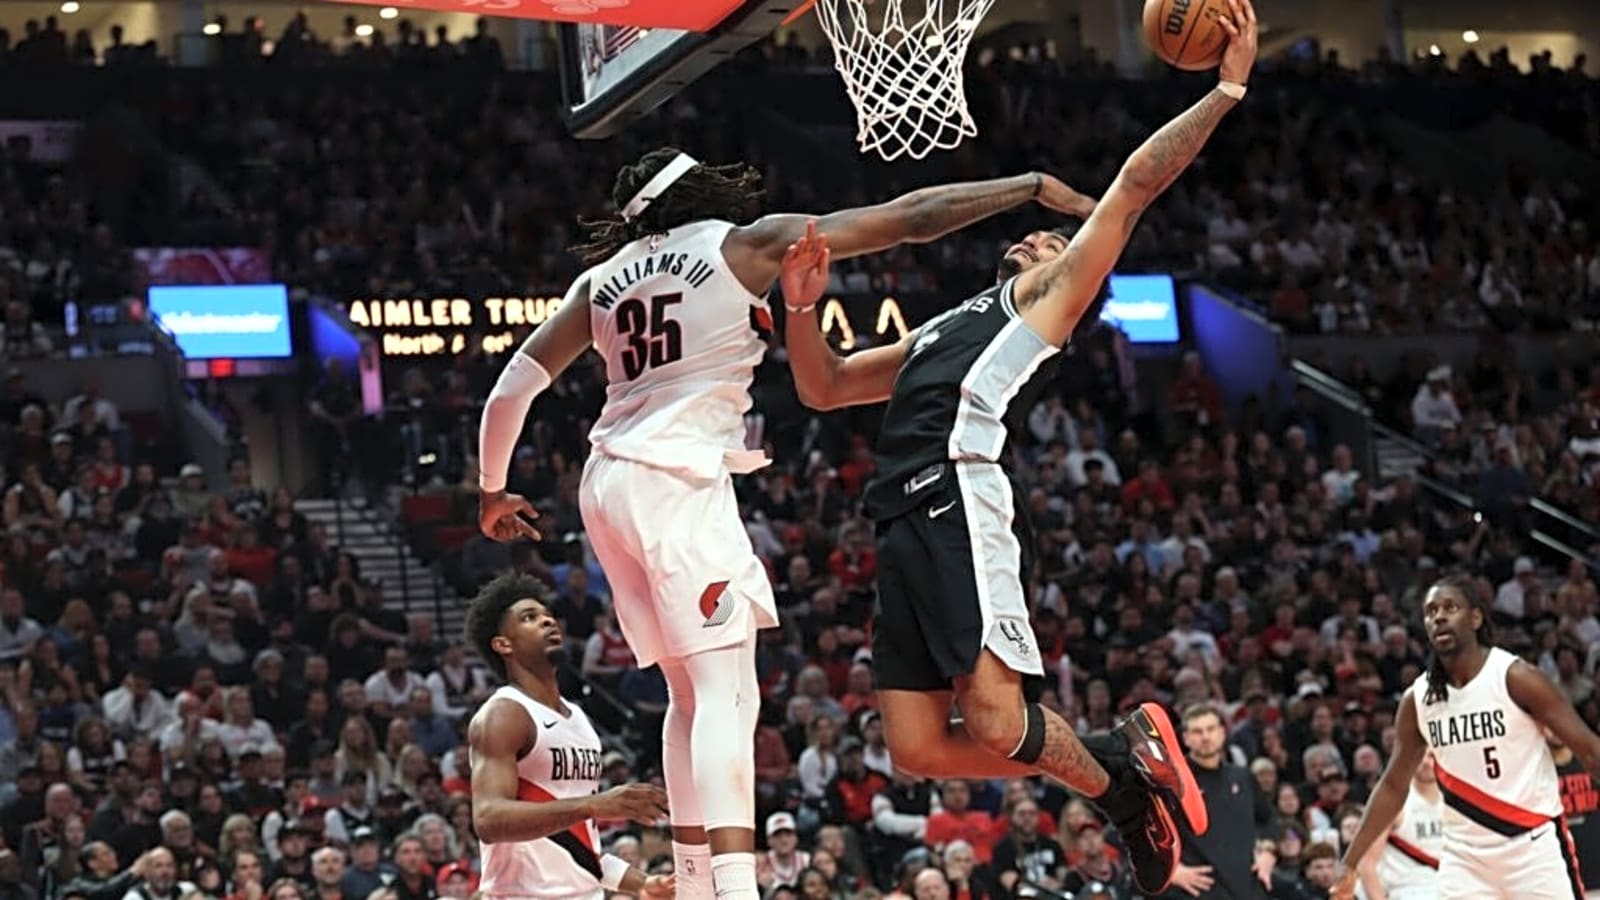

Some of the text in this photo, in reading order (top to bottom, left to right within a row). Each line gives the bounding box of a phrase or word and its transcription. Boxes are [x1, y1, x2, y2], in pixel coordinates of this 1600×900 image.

[592, 253, 714, 310] WILLIAMS III
[616, 292, 683, 381] 35
[1427, 709, 1506, 749] BLAZERS
[1483, 746, 1501, 780] 5
